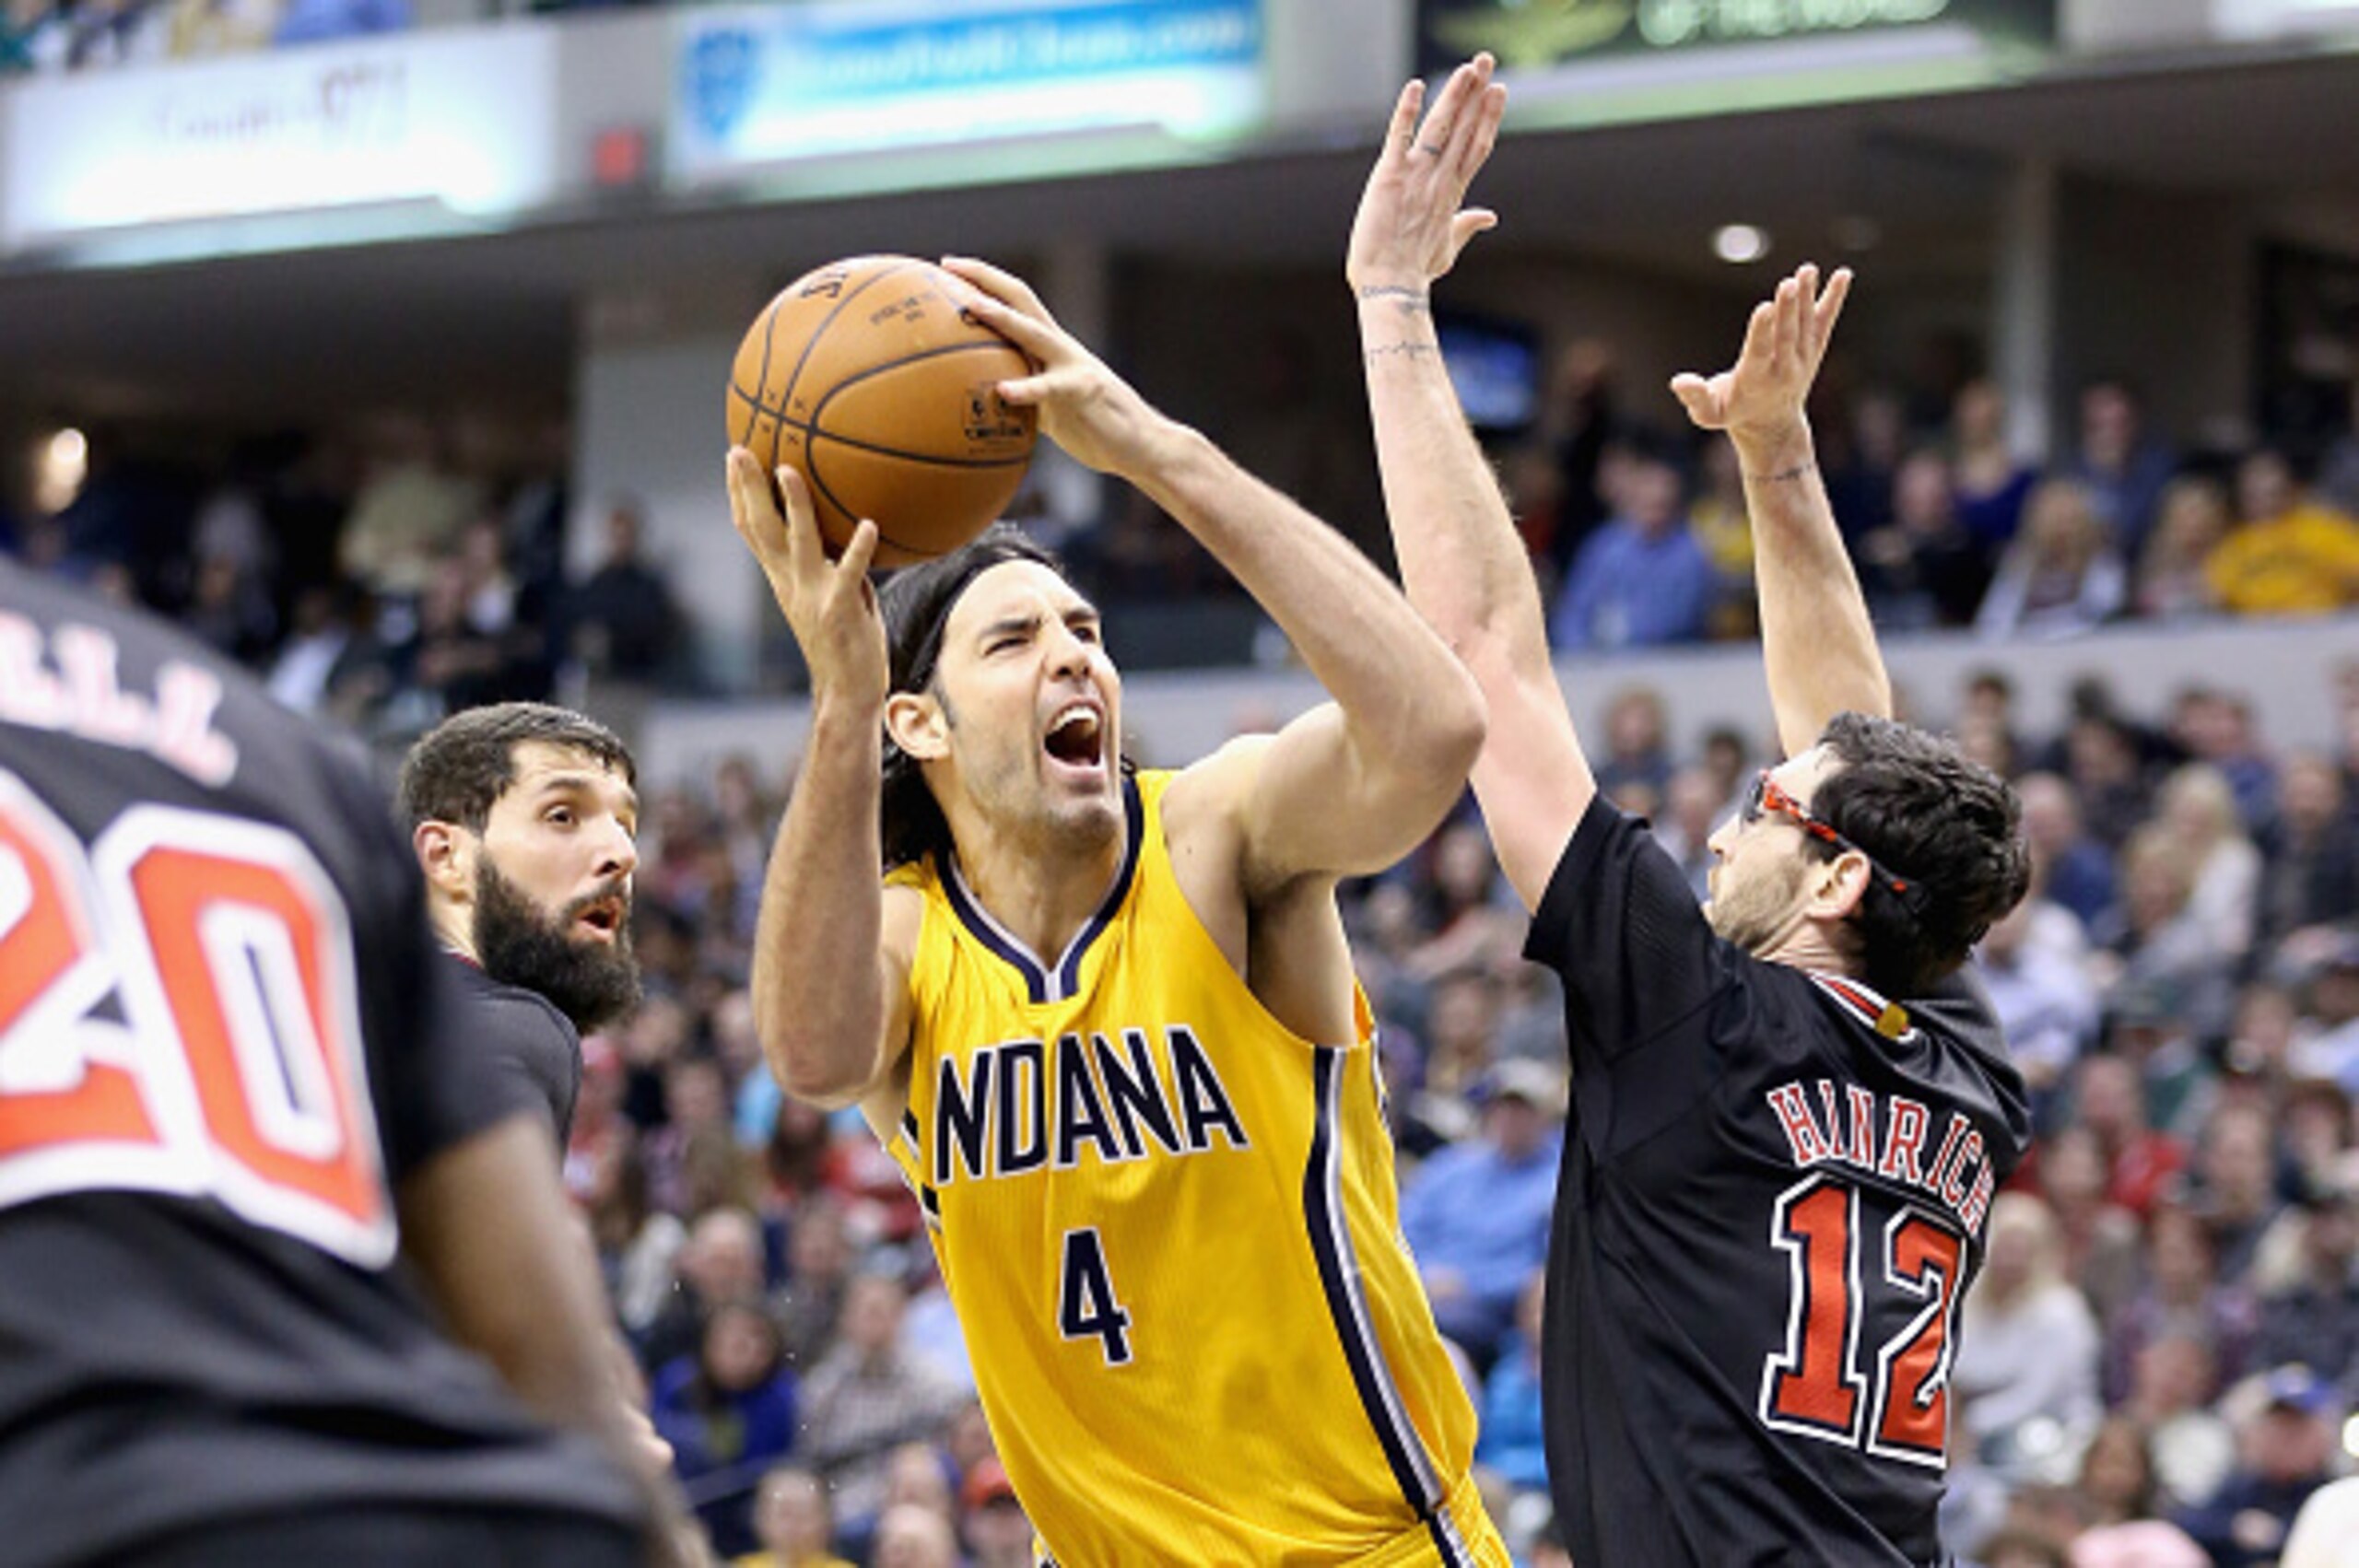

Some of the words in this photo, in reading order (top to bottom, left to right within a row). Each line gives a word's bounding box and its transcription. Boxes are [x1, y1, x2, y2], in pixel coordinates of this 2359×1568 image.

[0, 763, 399, 1272] 20
[1060, 1226, 1133, 1367] 4
[1757, 1169, 1969, 1470] 12
